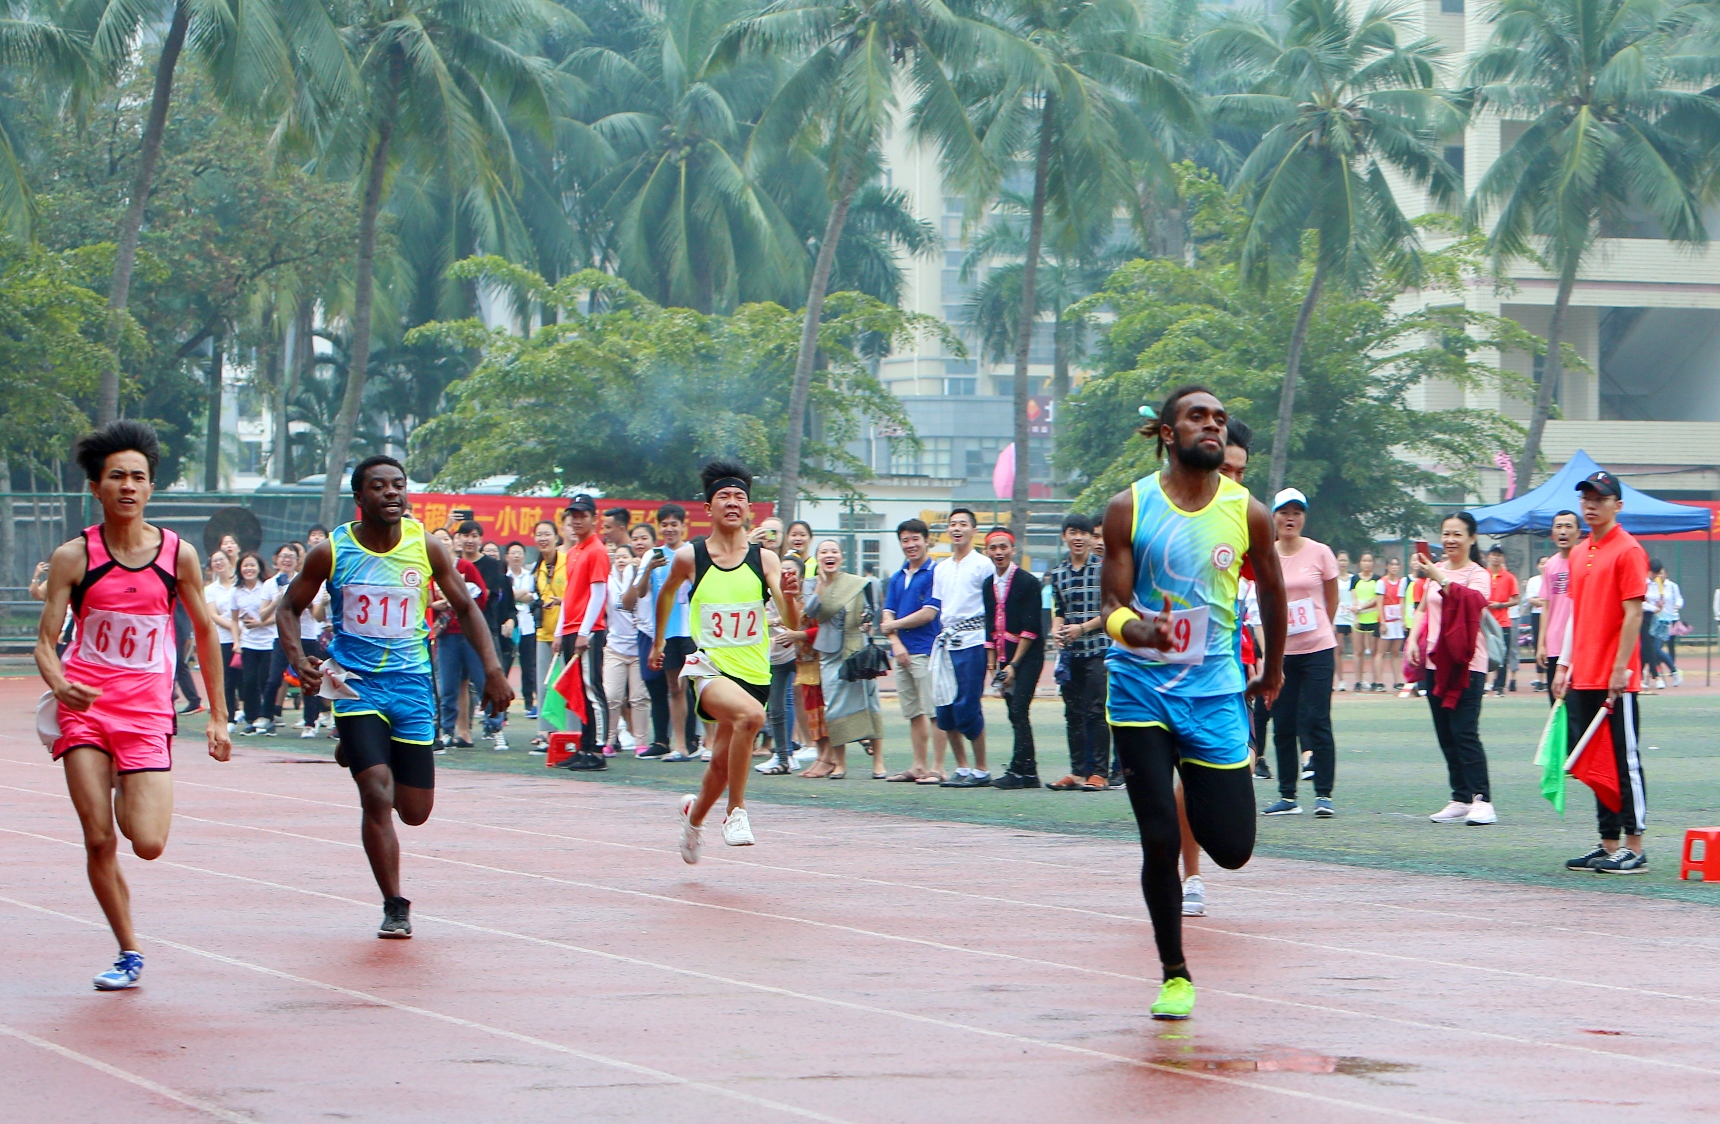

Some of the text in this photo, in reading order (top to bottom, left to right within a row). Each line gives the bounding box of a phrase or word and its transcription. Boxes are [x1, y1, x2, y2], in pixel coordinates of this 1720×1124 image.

[356, 594, 409, 628] 311
[711, 610, 757, 638] 372
[95, 619, 158, 662] 661
